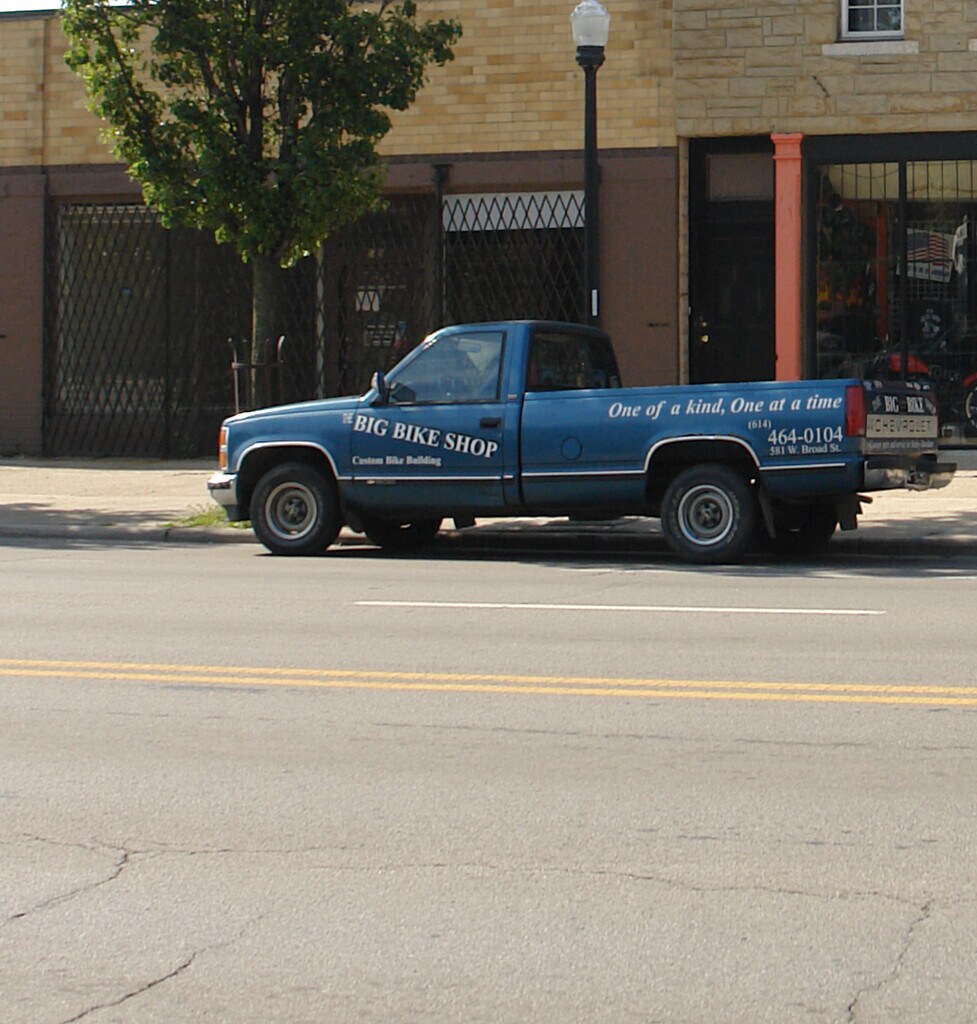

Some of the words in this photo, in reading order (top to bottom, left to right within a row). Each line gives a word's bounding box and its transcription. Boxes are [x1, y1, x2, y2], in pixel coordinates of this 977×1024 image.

[608, 402, 641, 418] One
[645, 400, 667, 420] of
[670, 403, 681, 415] a
[685, 398, 726, 416] kind,
[730, 397, 764, 414] One
[768, 397, 786, 412] at
[790, 398, 802, 411] a
[806, 394, 842, 410] time
[884, 395, 899, 412] BIG
[747, 419, 772, 430] (614)
[874, 419, 933, 433] CHEVROLET
[353, 414, 389, 436] BIG
[392, 422, 440, 447] BIKE
[443, 432, 498, 458] SHOP
[767, 425, 844, 446] 464-0104
[769, 445, 786, 456] 581
[787, 445, 800, 455] W.
[801, 443, 828, 454] Broad
[829, 443, 841, 453] St.
[352, 455, 384, 465] Custom
[385, 455, 404, 465] Bike
[406, 455, 441, 467] Building
